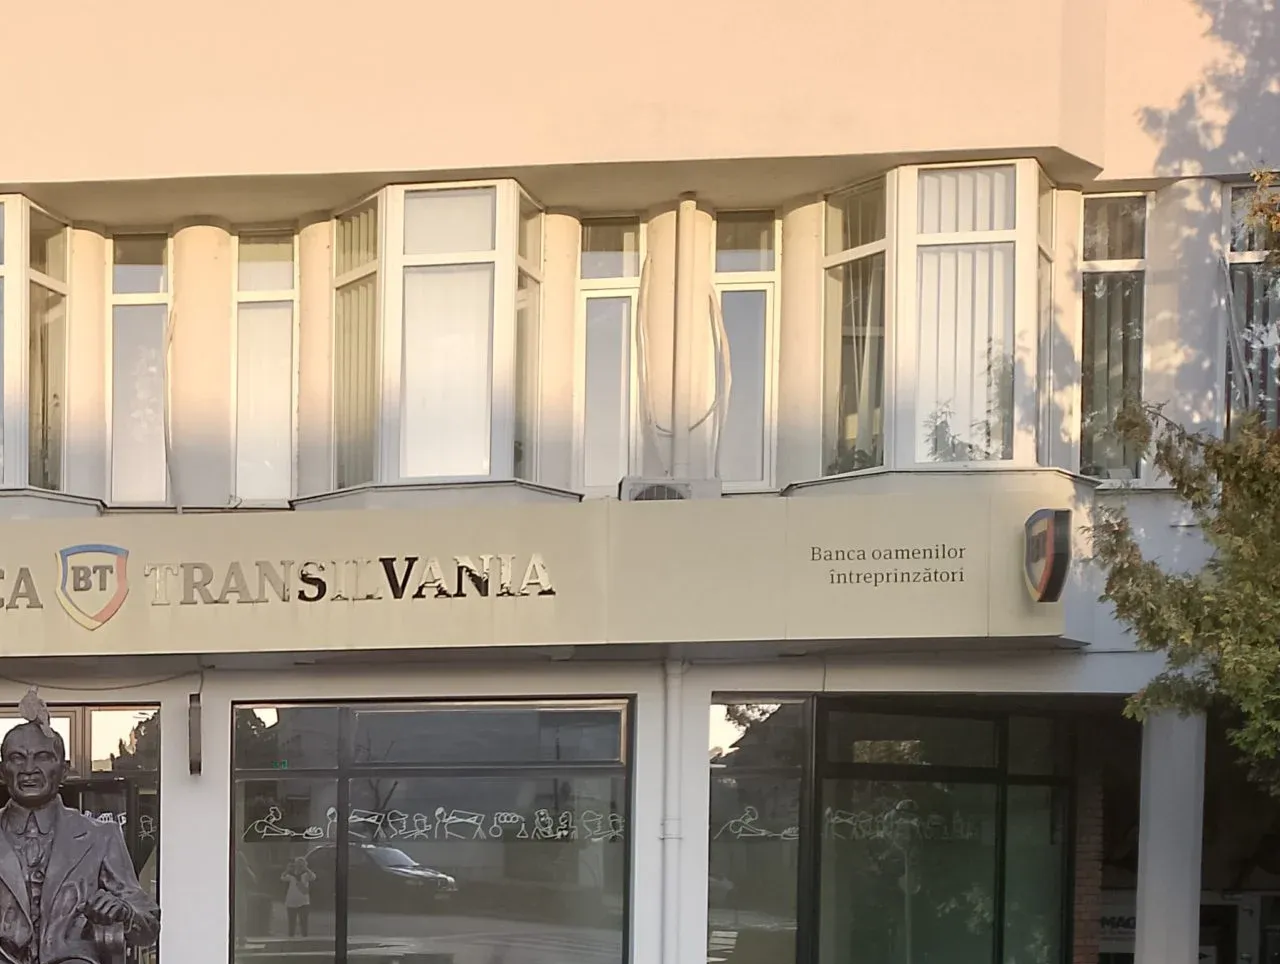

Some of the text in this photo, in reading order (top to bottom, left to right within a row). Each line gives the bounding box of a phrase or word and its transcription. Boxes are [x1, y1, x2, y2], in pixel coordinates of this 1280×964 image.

[811, 544, 967, 561] Banca oamenilor
[71, 565, 113, 591] BT
[143, 553, 557, 606] TRANSILVANIA
[829, 567, 965, 587] întreprinzători
